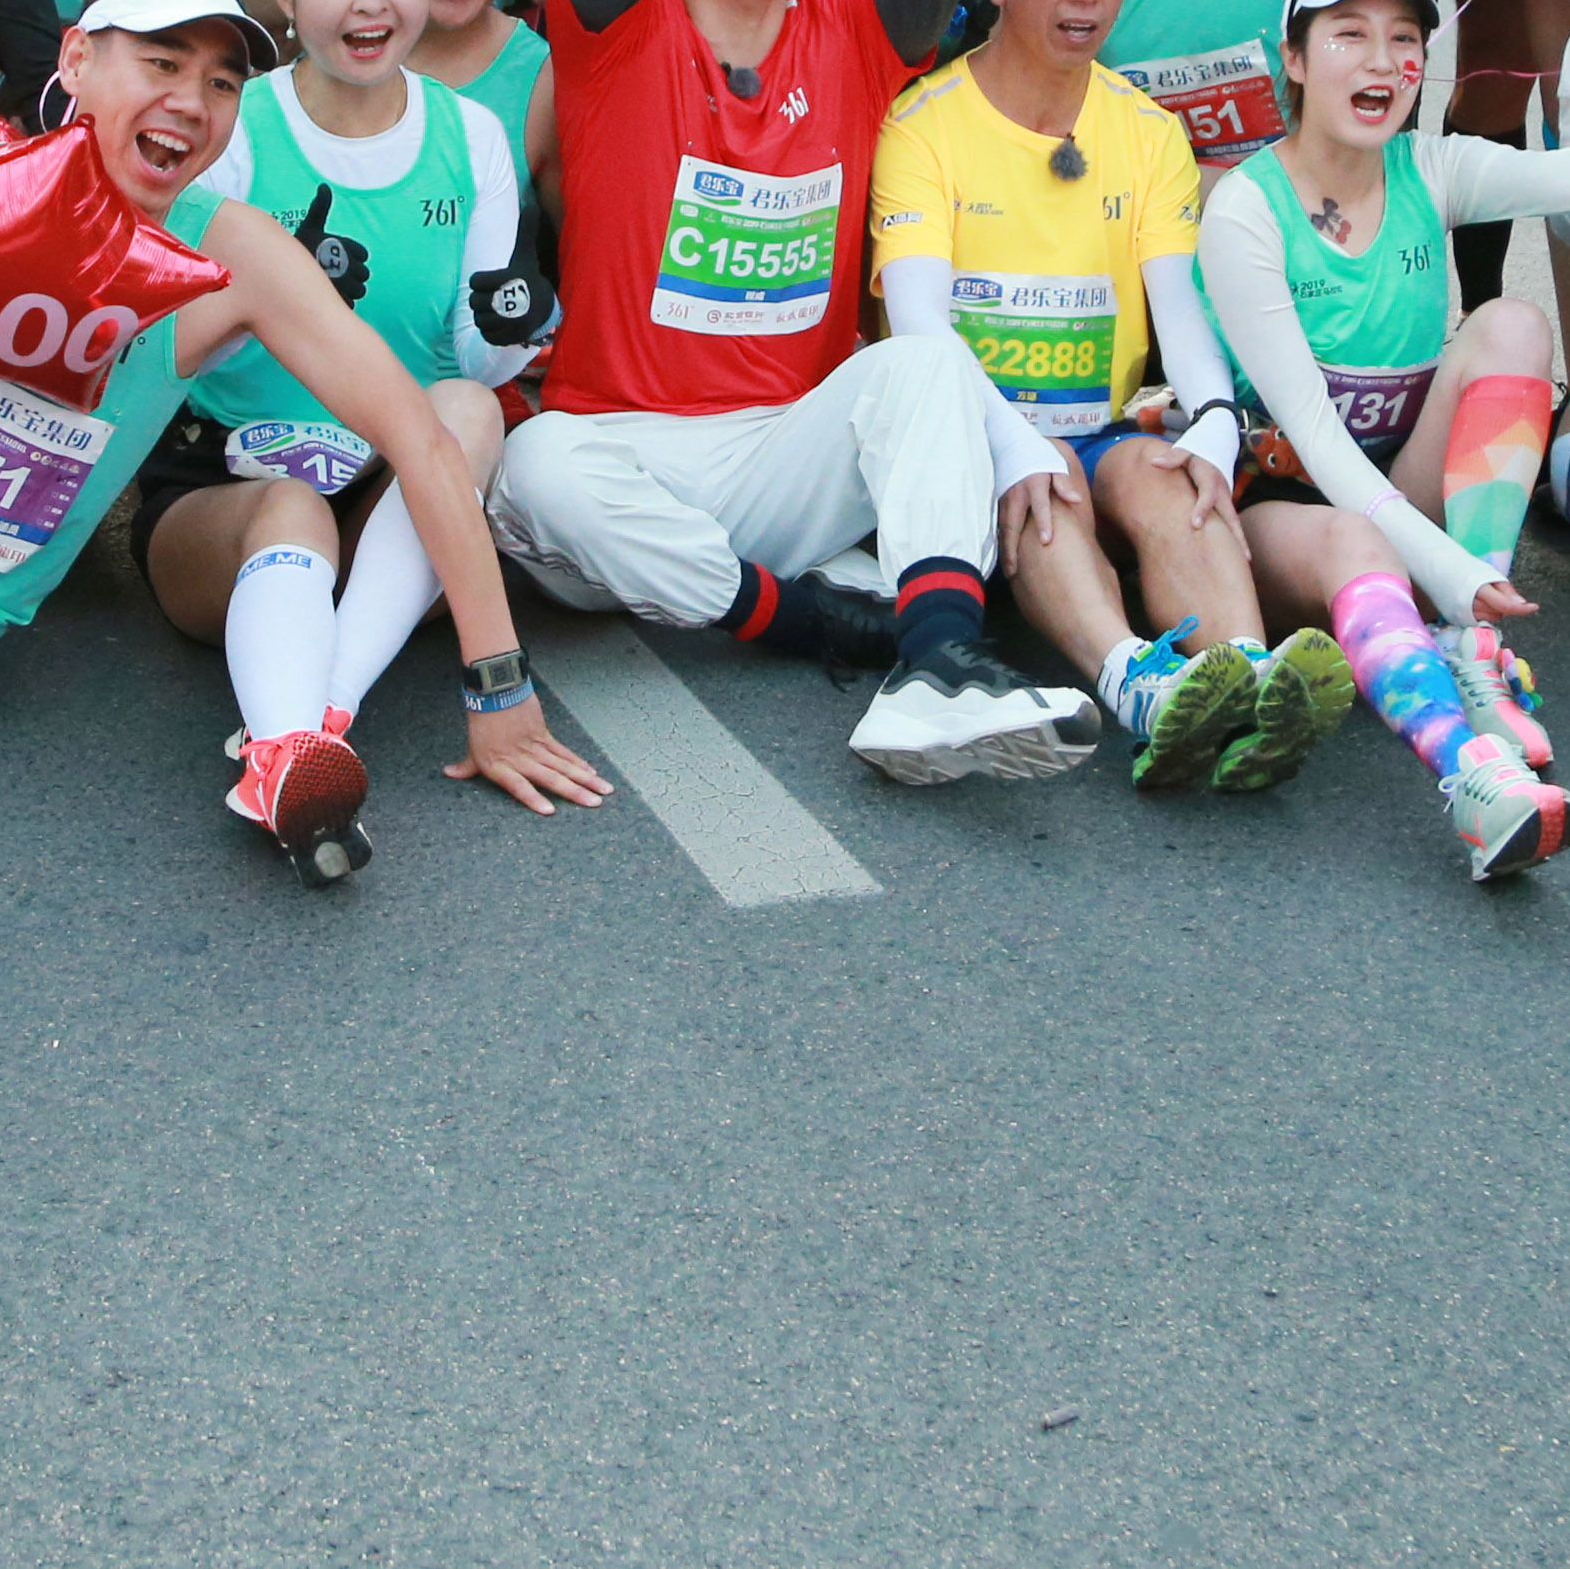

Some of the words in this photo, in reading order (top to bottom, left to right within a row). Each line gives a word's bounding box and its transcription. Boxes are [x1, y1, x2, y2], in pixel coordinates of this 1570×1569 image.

[1157, 55, 1252, 87] 君乐宝集团
[700, 174, 739, 194] 君乐宝
[750, 180, 831, 210] 君乐宝集团
[281, 210, 307, 220] 2019
[419, 195, 465, 227] 361°
[669, 226, 704, 267] C
[708, 234, 818, 278] 15555
[957, 281, 998, 297] 君乐宝
[1300, 279, 1326, 290] 2019
[1010, 287, 1107, 308] 君乐宝集团
[246, 425, 289, 443] 君乐宝
